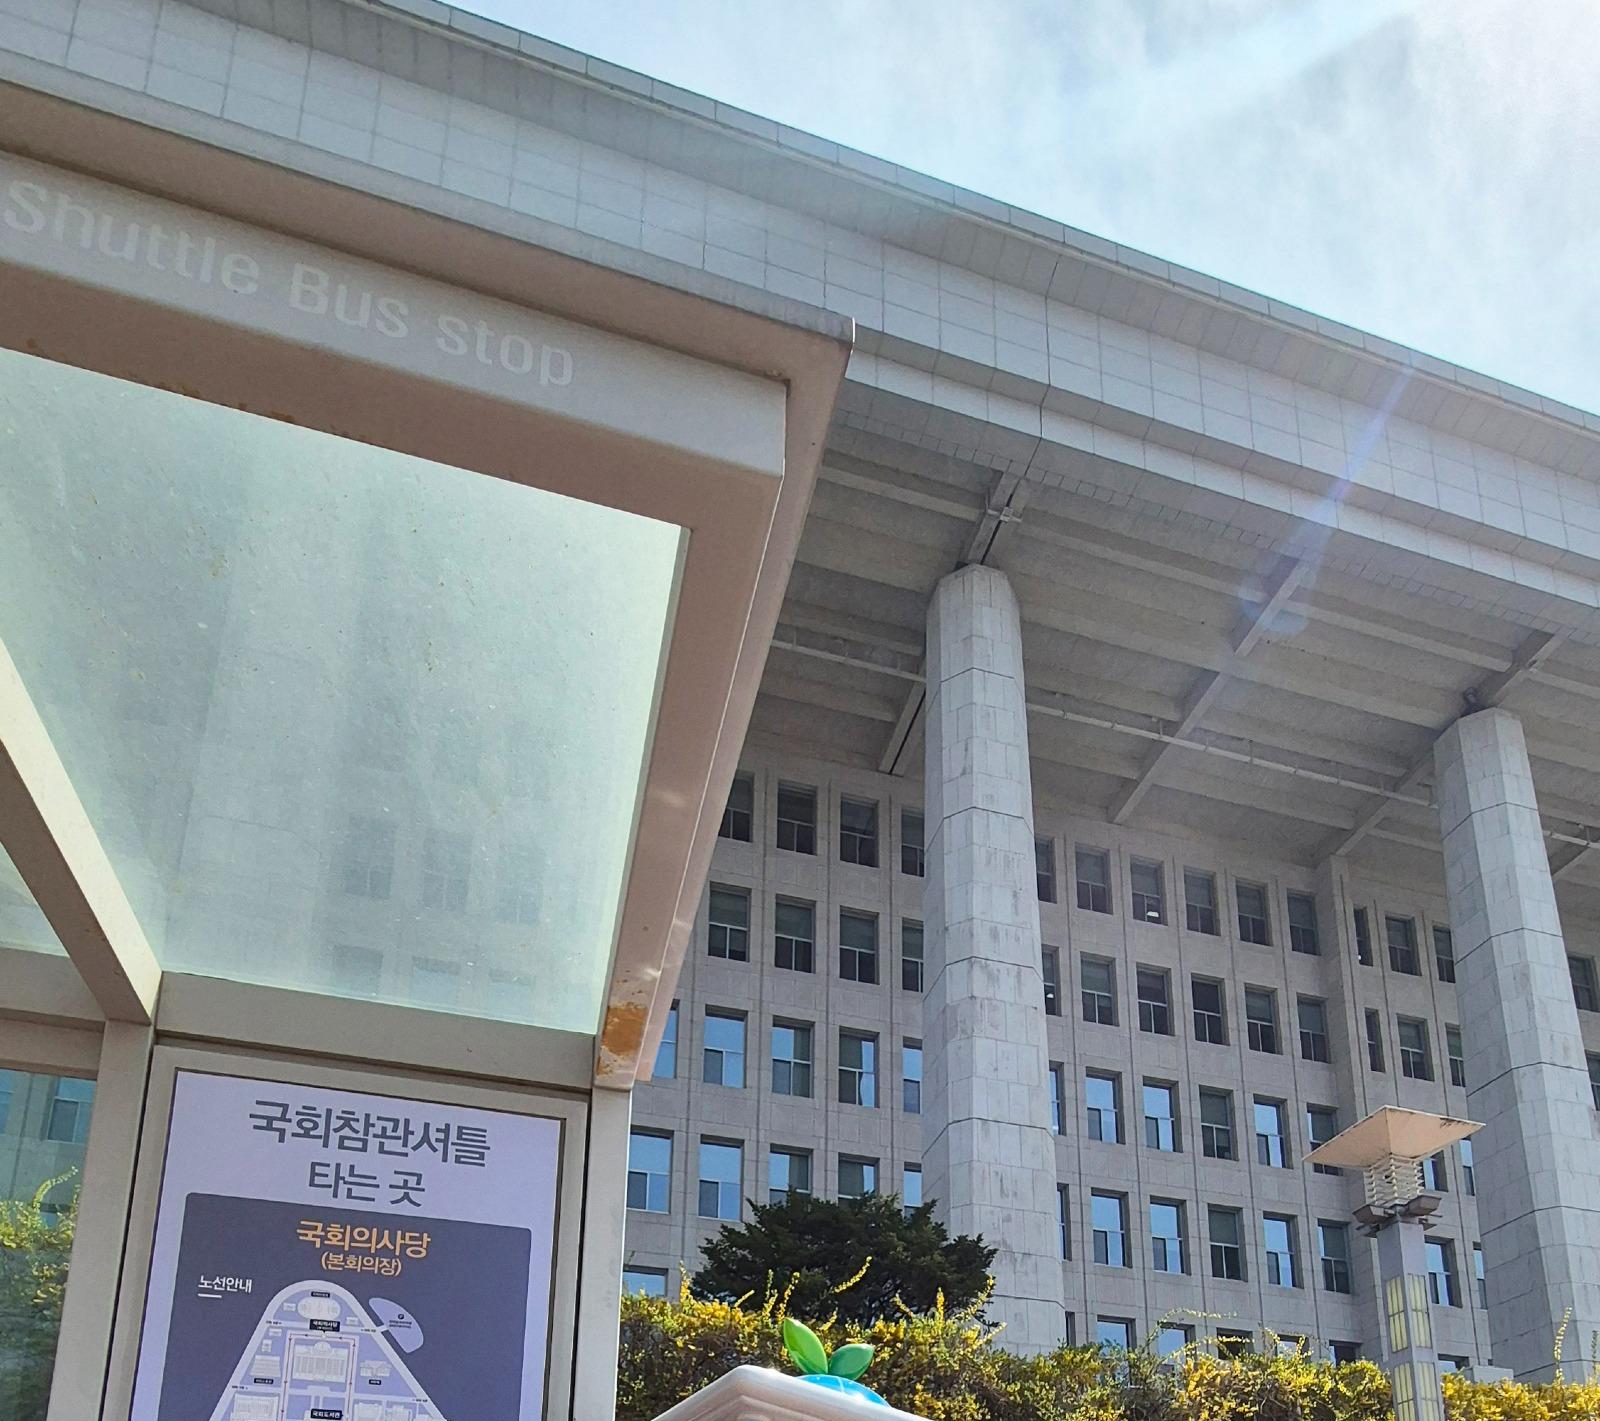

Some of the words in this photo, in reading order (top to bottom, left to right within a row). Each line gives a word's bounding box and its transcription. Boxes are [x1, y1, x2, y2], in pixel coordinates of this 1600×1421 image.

[3, 180, 260, 296] Shuttle
[289, 261, 409, 338] Bus
[436, 311, 575, 387] stop
[249, 1100, 491, 1167] 국회참관셔틀
[308, 1161, 380, 1202] 타는
[389, 1170, 426, 1208] 곳
[297, 1220, 431, 1259] 국회의사당
[198, 1275, 252, 1294] 노선안내
[321, 1252, 402, 1276] (본회의장)
